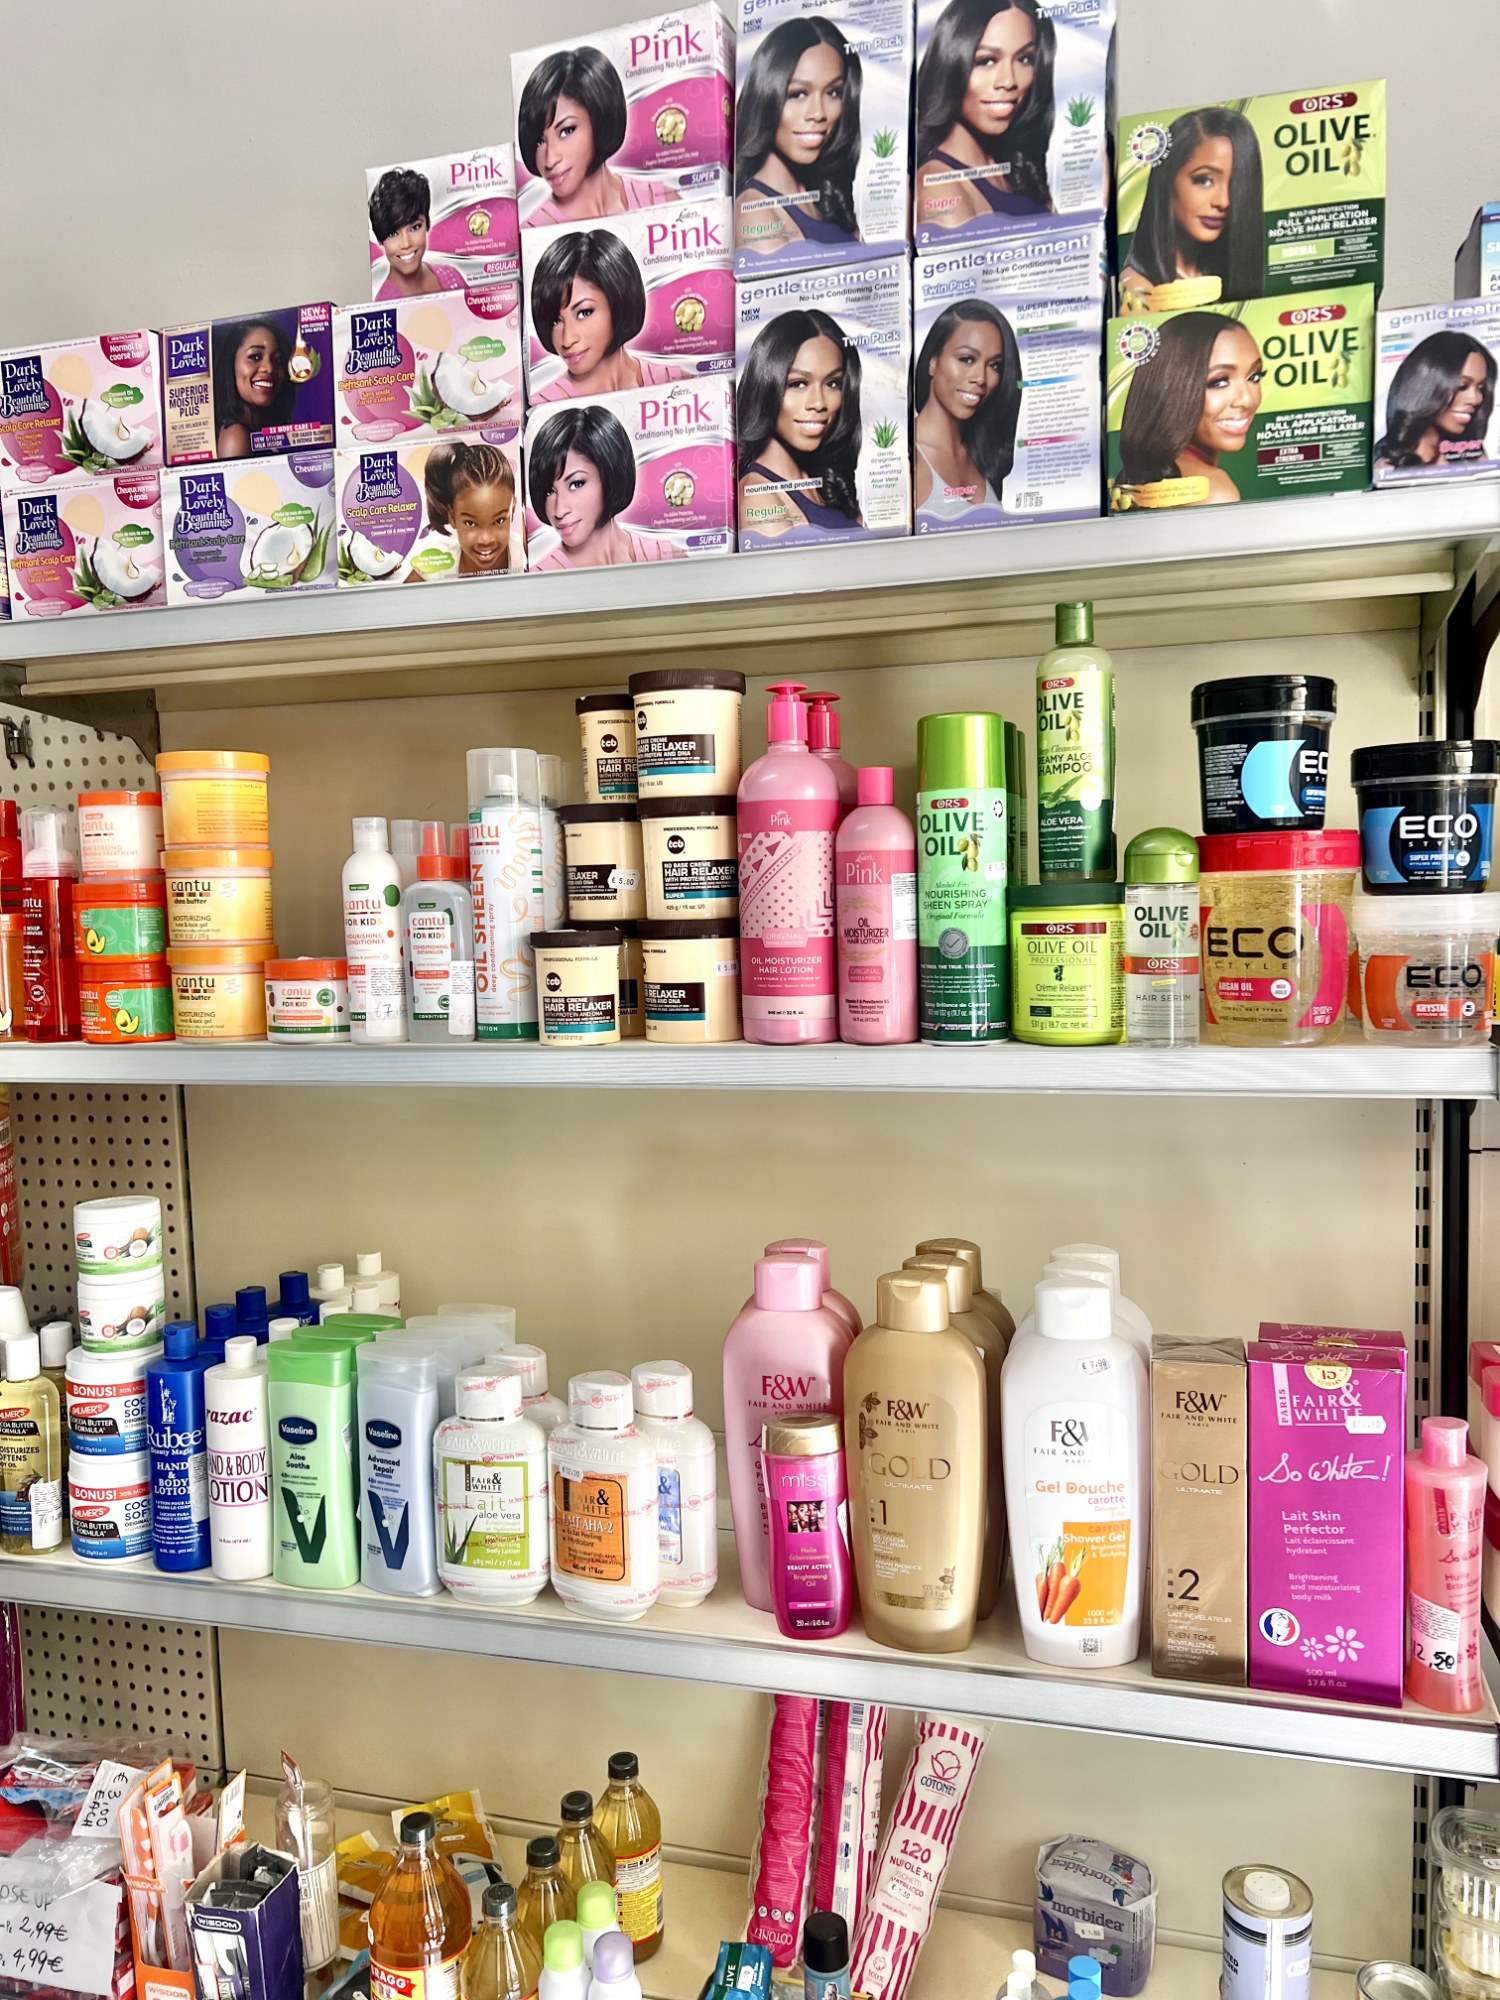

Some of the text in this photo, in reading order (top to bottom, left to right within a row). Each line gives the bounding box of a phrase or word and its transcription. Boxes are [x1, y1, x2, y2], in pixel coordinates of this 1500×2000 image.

[630, 24, 703, 67] Pink
[844, 35, 903, 54] Twin Pack
[1302, 93, 1344, 111] ORS
[1274, 114, 1371, 149] OLIVE
[1286, 149, 1340, 176] OIL
[450, 159, 502, 184] Pink
[925, 196, 961, 209] Super
[1278, 210, 1368, 227] FULL APPLICATION
[646, 217, 721, 254] Pink
[923, 233, 1090, 278] gentletreatment
[486, 261, 517, 272] REGULAR
[740, 263, 898, 303] gentletreatment
[1291, 309, 1333, 324] ORS
[171, 337, 205, 354] Dark
[842, 331, 900, 348] Twin Pack
[1262, 327, 1359, 360] OLIVE
[172, 355, 206, 370] Lovely
[5, 362, 38, 378] Dark
[1274, 361, 1328, 388] OIL
[5, 380, 41, 395] Lovely
[169, 384, 208, 398] SUPERIOR
[169, 395, 209, 409] MOISTURE
[179, 406, 200, 417] PLUS
[640, 394, 712, 430] Pink
[635, 430, 673, 441] Conditioning
[697, 424, 719, 432] Relaxer
[363, 454, 394, 469] Dark
[364, 468, 396, 482] Lovely
[185, 479, 220, 495] Dark
[746, 484, 778, 493] nourishes
[794, 479, 822, 489] protects
[944, 485, 977, 496] Super
[22, 501, 54, 516] Dark
[185, 496, 224, 511] Lovely
[346, 502, 417, 518] Scalp Care Relaxer
[746, 506, 789, 517] Regular
[22, 518, 56, 533] Lovely
[699, 535, 721, 544] SUPER
[651, 741, 696, 751] RELAXER
[599, 765, 621, 773] HAIR
[936, 800, 961, 808] ORS
[770, 815, 792, 826] Pink
[920, 812, 984, 834] OLIVE
[1041, 816, 1083, 826] ALOE VERA
[1400, 814, 1478, 839] ECO
[668, 840, 684, 848] tcb
[925, 837, 961, 857] OIL
[664, 866, 735, 876] HAIR RELAXER
[846, 862, 883, 884] Pink
[171, 880, 211, 892] cantu
[925, 890, 986, 899] NOURISHING
[345, 899, 382, 911] cantu
[924, 900, 988, 909] SHEEN SPRAY
[1135, 906, 1189, 921] OLIVE
[412, 916, 445, 926] cantu
[472, 864, 488, 993] OIL SHEEN
[1045, 924, 1074, 934] ORS
[1140, 924, 1171, 938] OIL
[1027, 941, 1097, 954] OLIVE OIL
[1207, 926, 1304, 959] ECO
[765, 956, 822, 964] MOISTURIZER
[1148, 959, 1179, 968] ORS
[1407, 964, 1482, 988] ECO
[1061, 984, 1088, 992] Relaxer
[1219, 982, 1253, 991] ARGAN OIL
[1136, 994, 1157, 1002] HAIR
[545, 1001, 611, 1012] HAIR RELAXER
[1416, 1004, 1448, 1012] KRYSTAL
[73, 1385, 116, 1396] BONUS!
[762, 1375, 813, 1400] F&W
[1176, 1391, 1223, 1412] F&W
[1293, 1383, 1362, 1407] FAIR &
[749, 1401, 767, 1409] FAIR
[887, 1400, 926, 1420] F&W
[1279, 1389, 1290, 1423] PARIS
[88, 1419, 113, 1427] BUTTER
[281, 1424, 314, 1435] Vaseline
[147, 1424, 203, 1449] Rubee
[368, 1427, 399, 1440] Vaseline
[157, 1462, 188, 1470] HAND
[226, 1460, 233, 1475] &
[236, 1452, 266, 1474] BODY
[368, 1455, 400, 1466] Advanced
[868, 1453, 951, 1480] GOLD
[374, 1465, 394, 1474] Repair
[1160, 1461, 1238, 1484] GOLD
[1259, 1453, 1302, 1483] So
[1308, 1453, 1380, 1481] White
[159, 1479, 187, 1487] BODY
[493, 1472, 501, 1484] &
[782, 1474, 827, 1487] miss
[209, 1477, 269, 1503] OTION
[885, 1482, 933, 1490] ULTIMATE
[1035, 1480, 1124, 1494] Gel Douche
[1088, 1496, 1125, 1504] carotte
[1282, 1511, 1340, 1521] Lait Skin
[563, 1516, 613, 1533] LAIT AHA-2
[1284, 1524, 1345, 1534] Perfector
[1063, 1533, 1125, 1543] Shower Gel
[1303, 1537, 1354, 1545] éclaircissant
[1178, 1569, 1200, 1600] 2
[1289, 1574, 1338, 1582] Brightening
[920, 1776, 956, 1797] COTONET
[900, 1839, 932, 1863] 120
[924, 1871, 933, 1882] XL
[35, 1895, 52, 1911] UP
[198, 1917, 237, 1929] WISDOM
[1052, 1901, 1124, 1932] morbidea
[1050, 1929, 1062, 1939] 14
[148, 1986, 188, 1998] WISDOM
